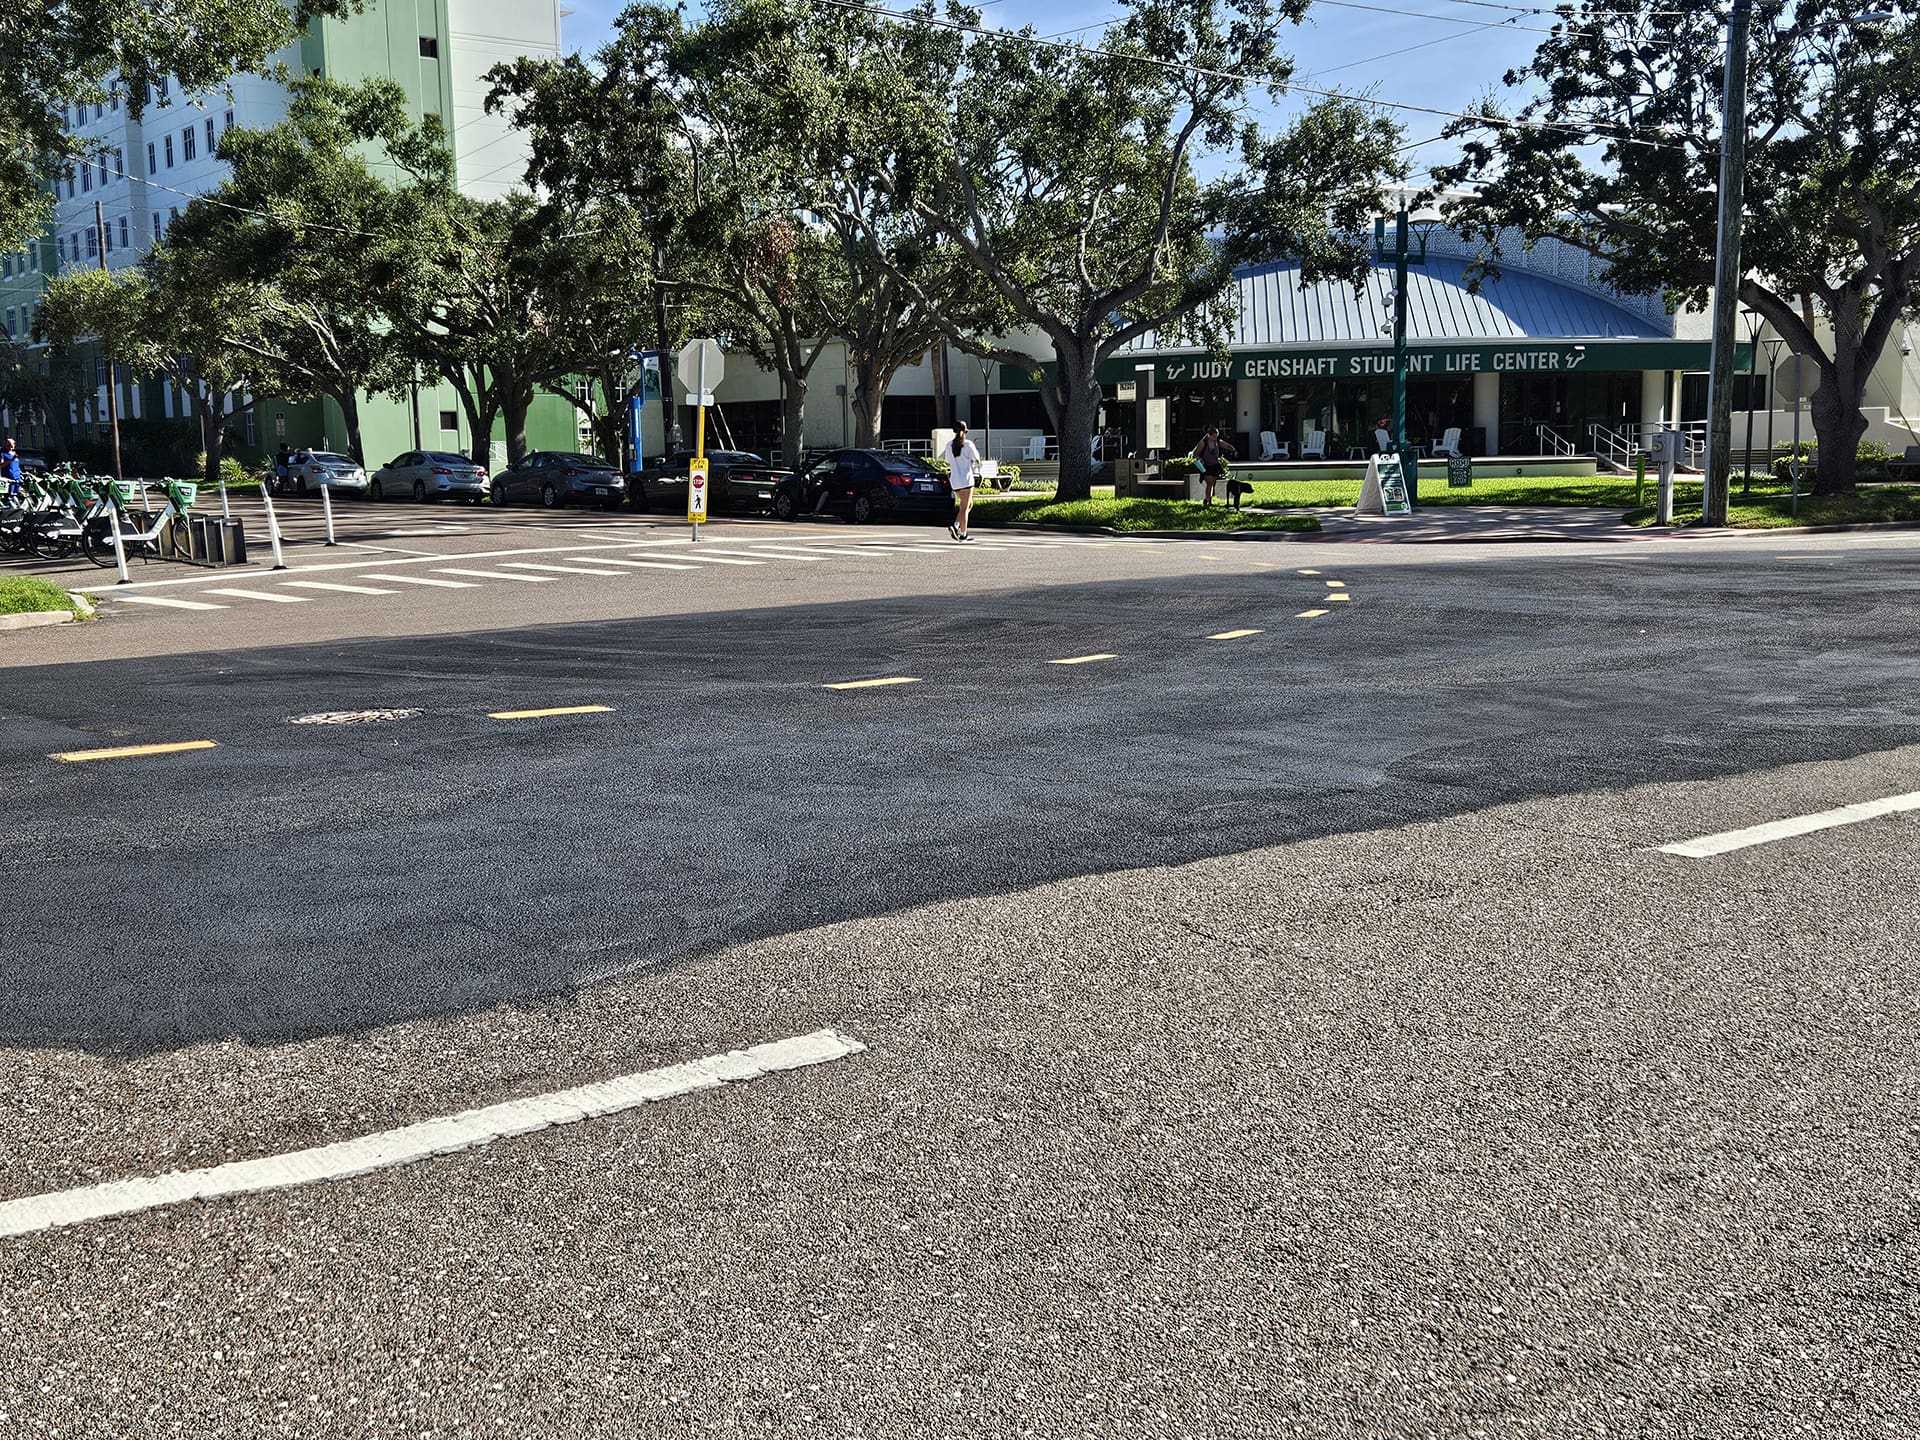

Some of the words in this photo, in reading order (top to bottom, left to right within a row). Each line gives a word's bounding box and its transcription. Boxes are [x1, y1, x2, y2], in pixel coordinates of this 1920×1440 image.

[1191, 360, 1234, 379] JUDY
[1245, 357, 1338, 377] GENSHAFT
[1349, 354, 1433, 374] STUDNT
[1445, 353, 1481, 372] LIFE
[1493, 352, 1559, 371] CENTER
